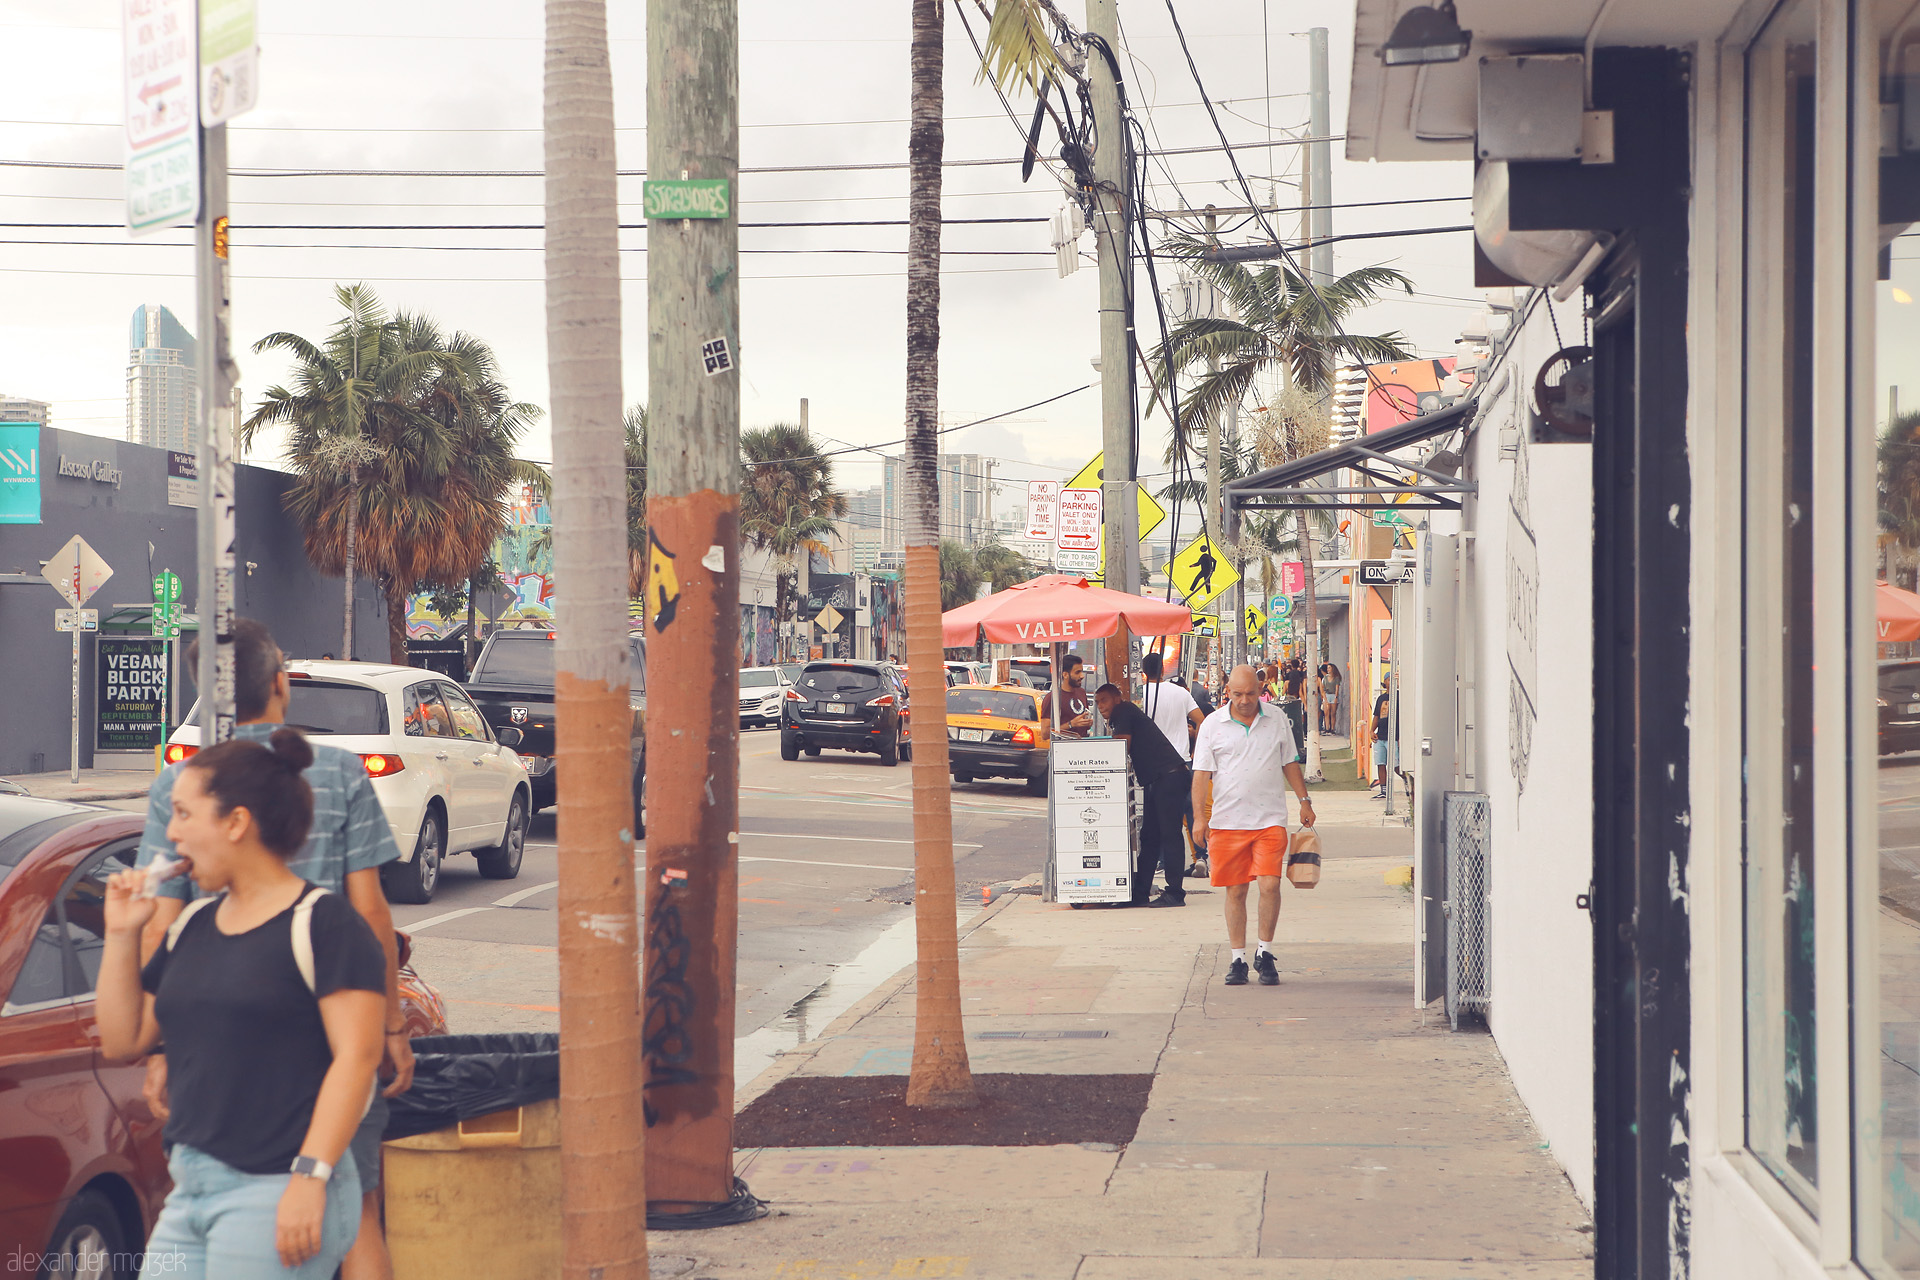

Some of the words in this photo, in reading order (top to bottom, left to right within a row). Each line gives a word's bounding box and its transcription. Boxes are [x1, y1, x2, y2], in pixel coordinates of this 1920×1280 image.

[59, 454, 92, 480] Ascaso
[92, 460, 122, 490] Gallery
[1038, 484, 1048, 493] NO
[1030, 494, 1055, 503] PARKING
[1074, 493, 1087, 501] NO
[1036, 504, 1048, 512] ANY
[1062, 502, 1098, 511] PARKING
[1035, 514, 1050, 523] TIME
[1016, 618, 1089, 639] VALET
[107, 654, 163, 669] VEGAN
[107, 670, 163, 684] BLOCK
[107, 686, 163, 700] PARTY
[115, 703, 155, 711] SATURDAY
[102, 712, 152, 720] SEPTEMBER
[103, 723, 125, 731] MANA
[1007, 722, 1018, 730] 372
